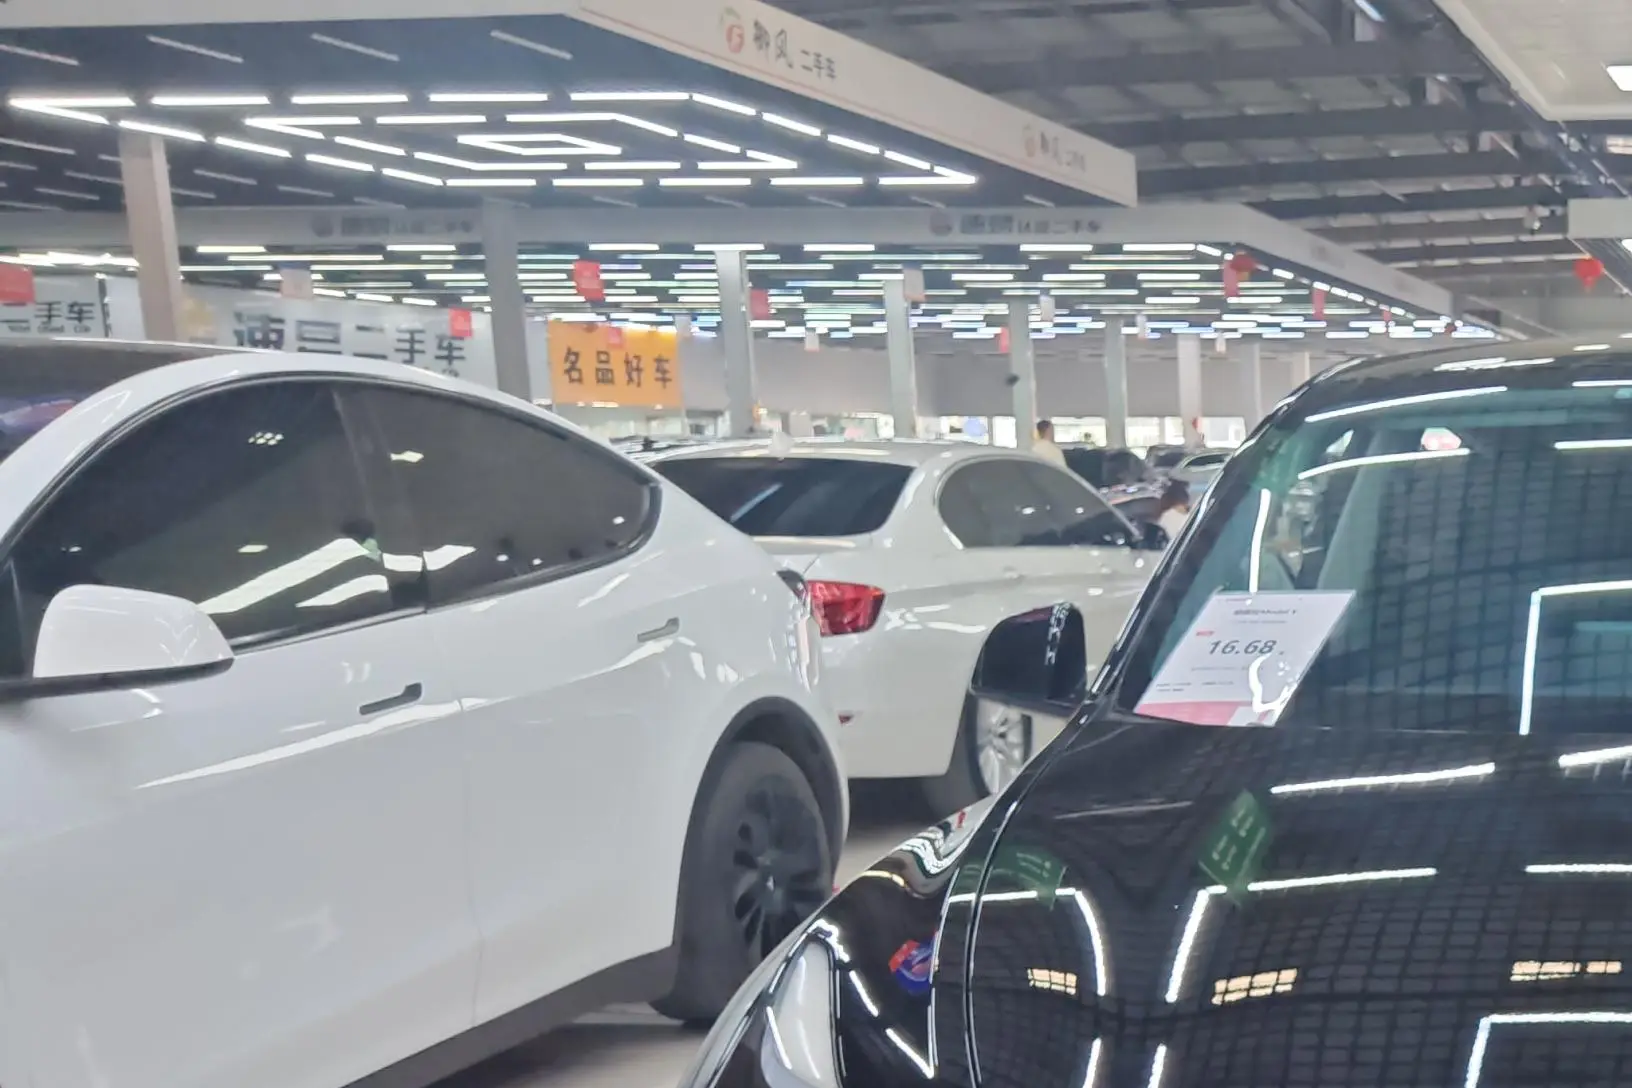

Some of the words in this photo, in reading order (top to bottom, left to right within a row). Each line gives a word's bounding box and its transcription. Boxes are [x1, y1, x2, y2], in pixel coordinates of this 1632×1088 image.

[564, 346, 672, 389] 名品好车
[1209, 640, 1277, 655] 16.68
